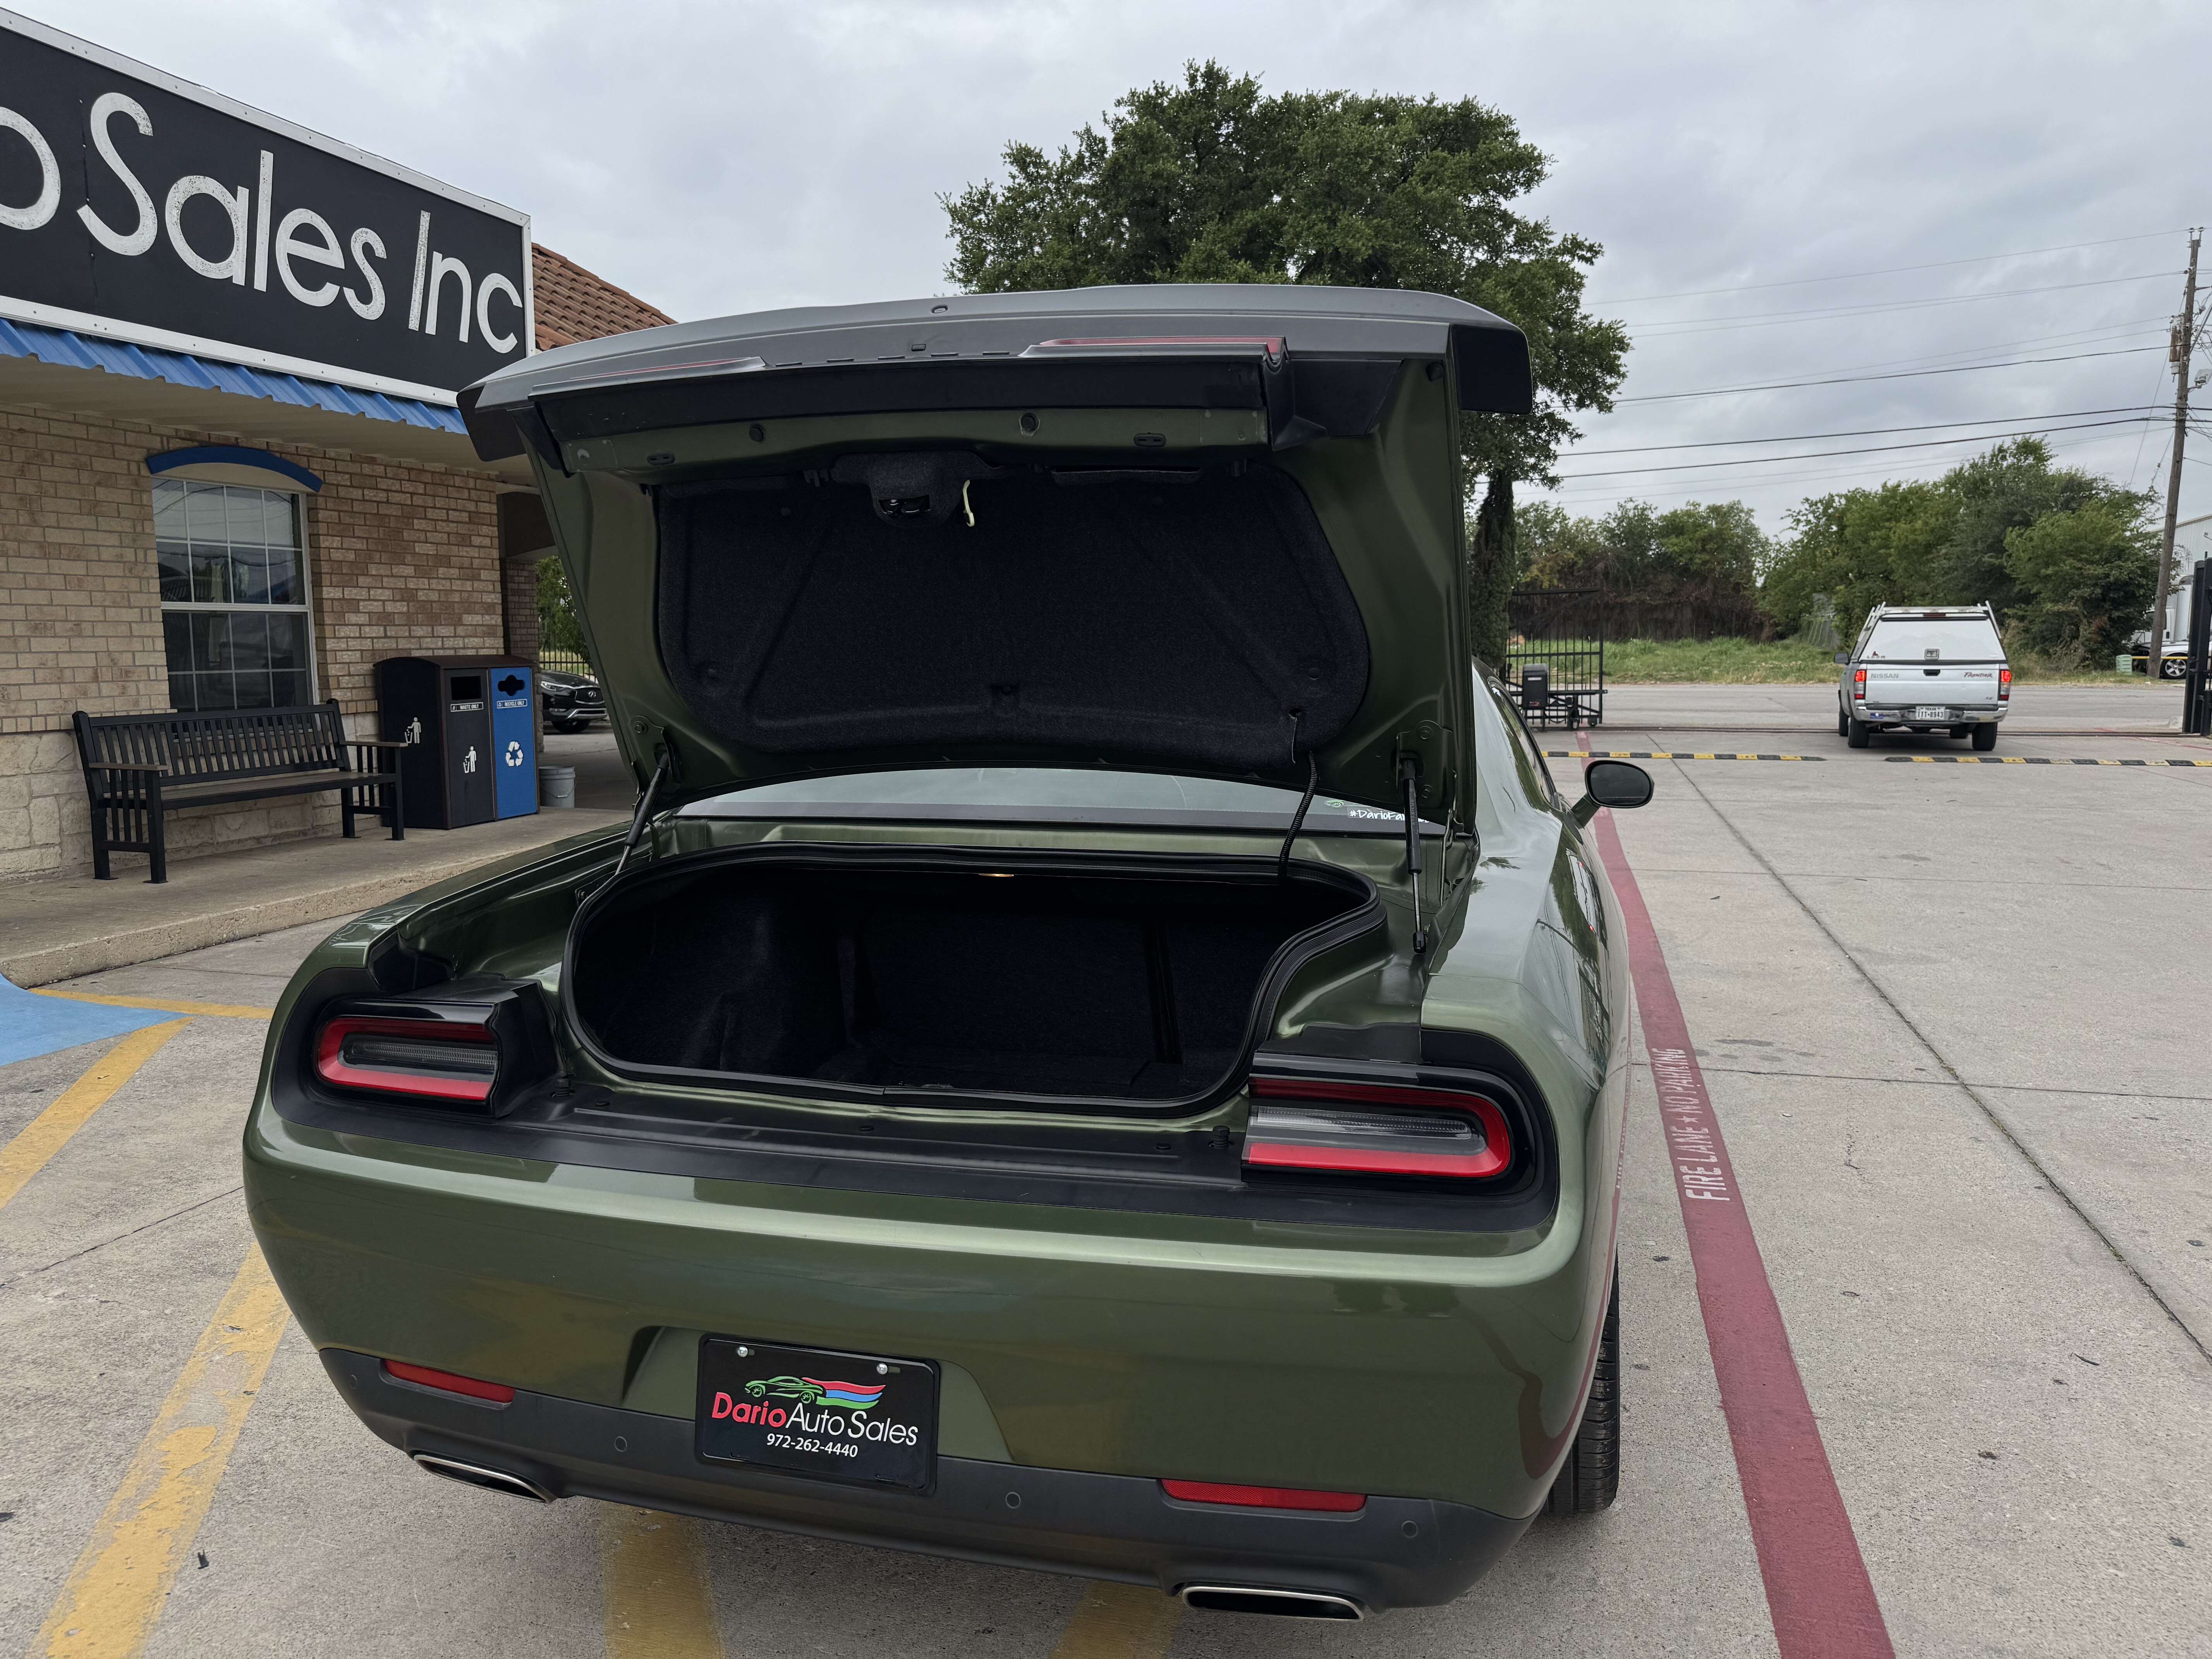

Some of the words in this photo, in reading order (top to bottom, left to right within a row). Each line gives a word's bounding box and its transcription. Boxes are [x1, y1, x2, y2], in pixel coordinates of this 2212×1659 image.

[77, 92, 387, 321] Sales
[408, 210, 523, 354] Inc
[1652, 1048, 1697, 1094] PARKING
[1663, 1095, 1703, 1114] NO
[1670, 1125, 1718, 1163] LANE
[1679, 1165, 1730, 1201] FIRE
[767, 1433, 858, 1458] 972-262-4440
[848, 1410, 919, 1446] Sales
